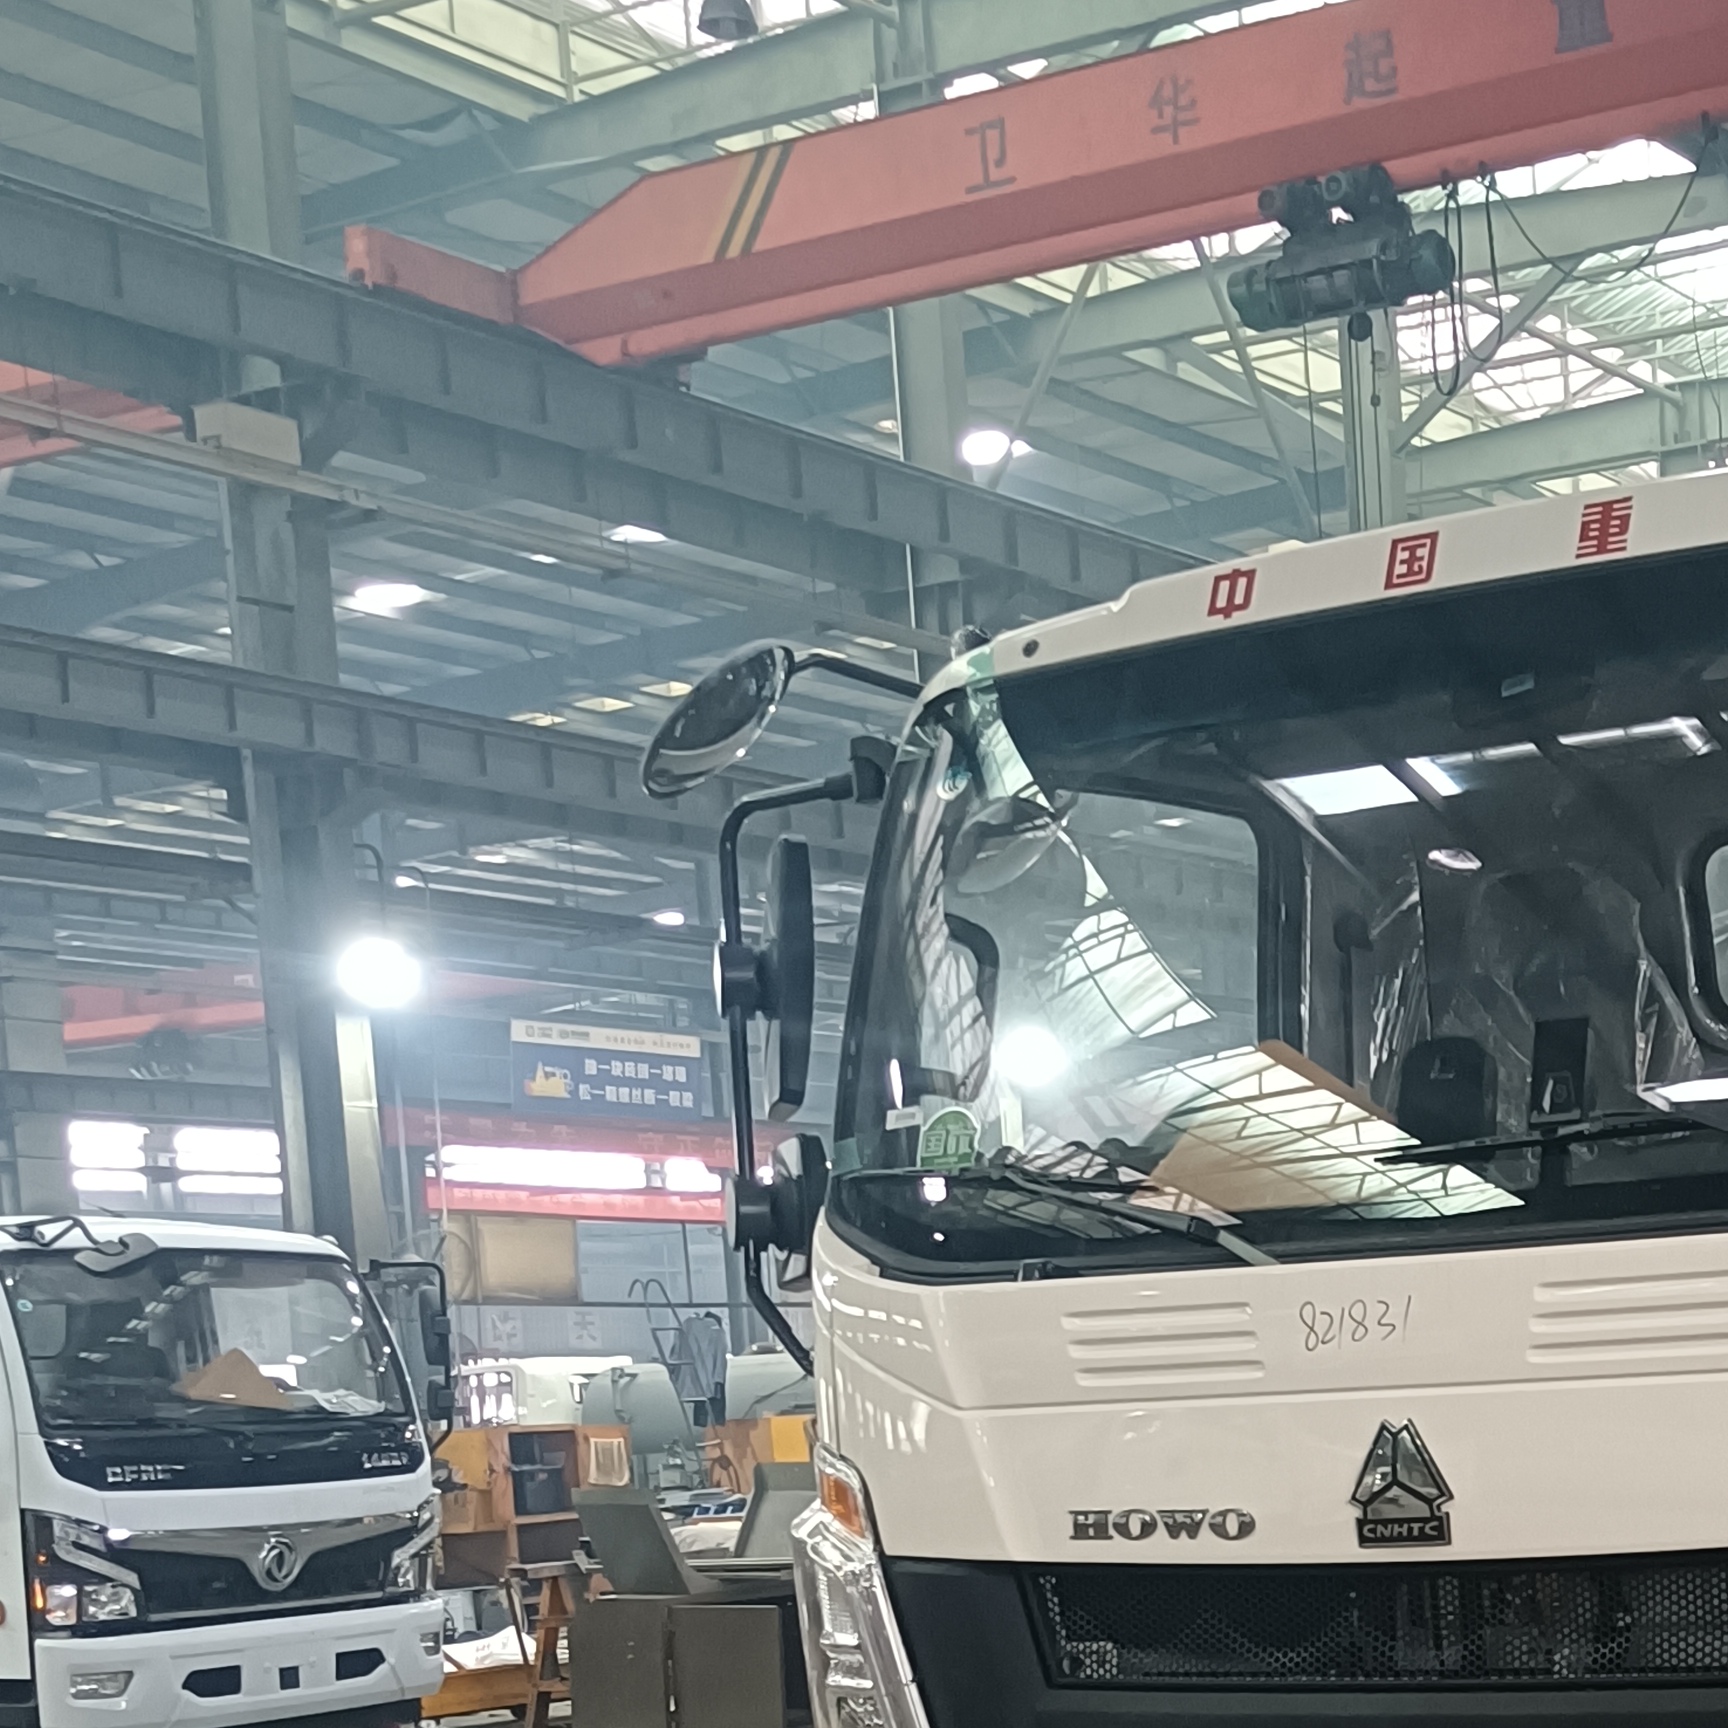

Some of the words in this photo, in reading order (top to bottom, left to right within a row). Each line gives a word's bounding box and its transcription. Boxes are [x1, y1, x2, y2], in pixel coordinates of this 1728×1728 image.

[1301, 1295, 1412, 1353] 821831
[1068, 1508, 1257, 1541] HOWO
[1361, 1519, 1440, 1540] CNHTC
